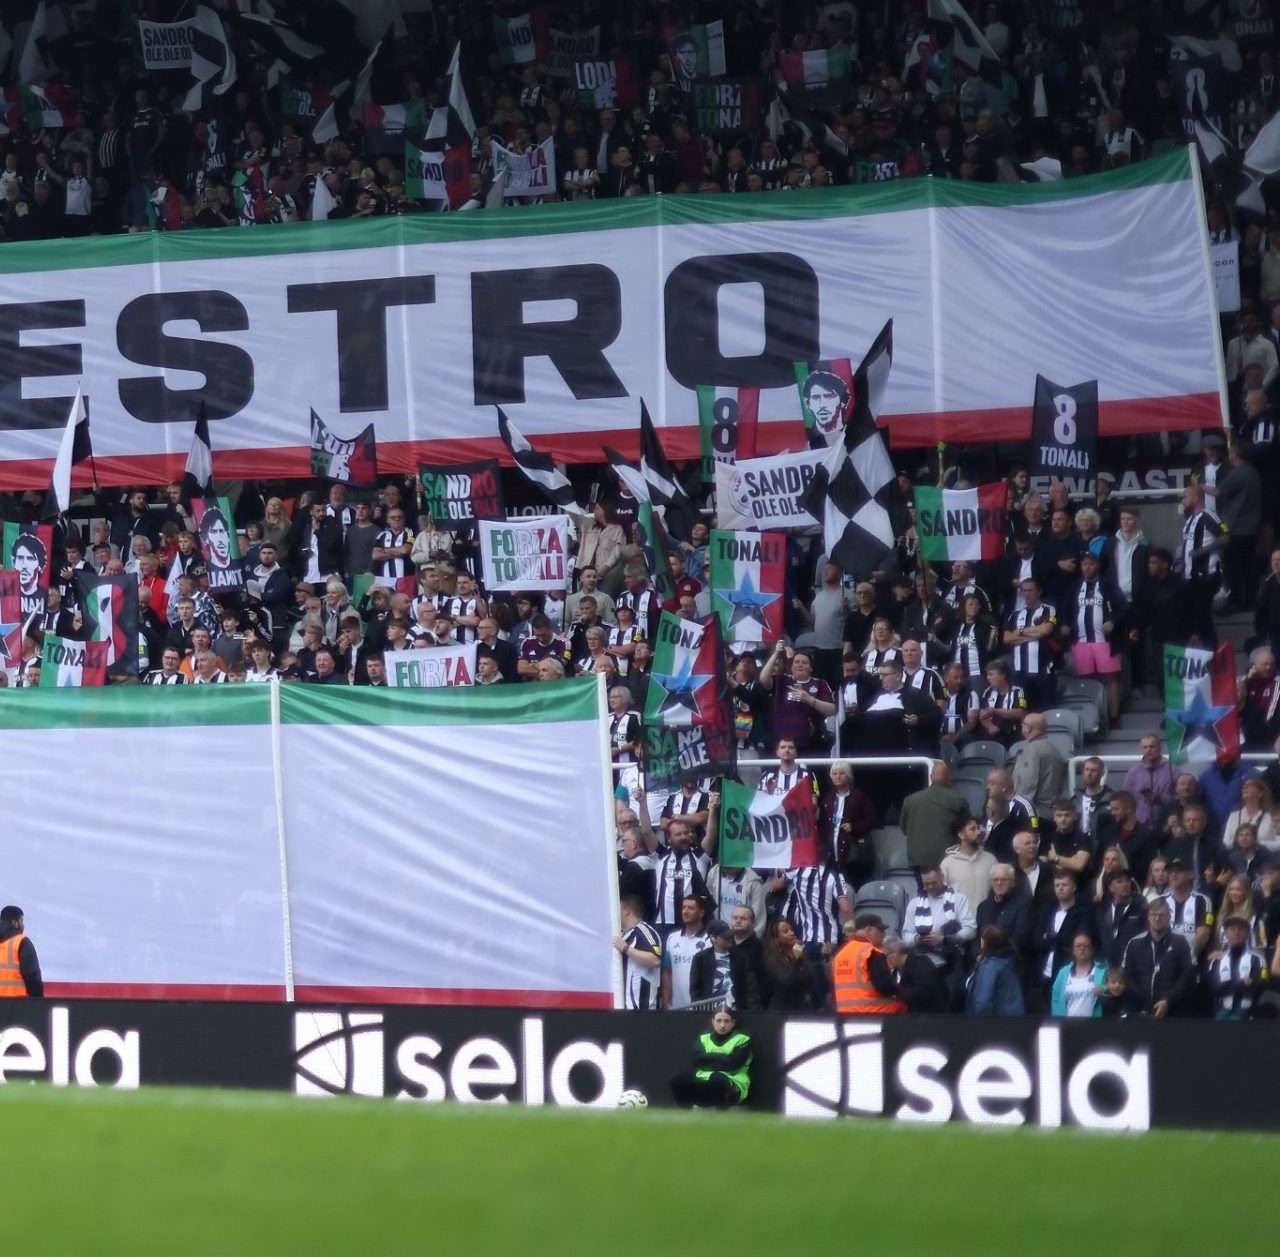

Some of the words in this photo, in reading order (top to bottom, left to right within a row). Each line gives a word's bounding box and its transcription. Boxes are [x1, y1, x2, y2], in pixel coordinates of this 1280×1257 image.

[711, 397, 737, 453] 8
[1053, 394, 1077, 444] 8
[1040, 446, 1089, 470] TONALI
[421, 472, 498, 500] SANDRO
[448, 501, 475, 520] OLE
[752, 499, 781, 519] OLE
[491, 528, 563, 556] FORZA
[716, 537, 781, 562] TONALI
[493, 556, 564, 583] TONALI
[46, 641, 104, 668] TONALI
[394, 656, 473, 687] FORZA
[394, 1018, 624, 1109] sela
[895, 1025, 1149, 1131] sela
